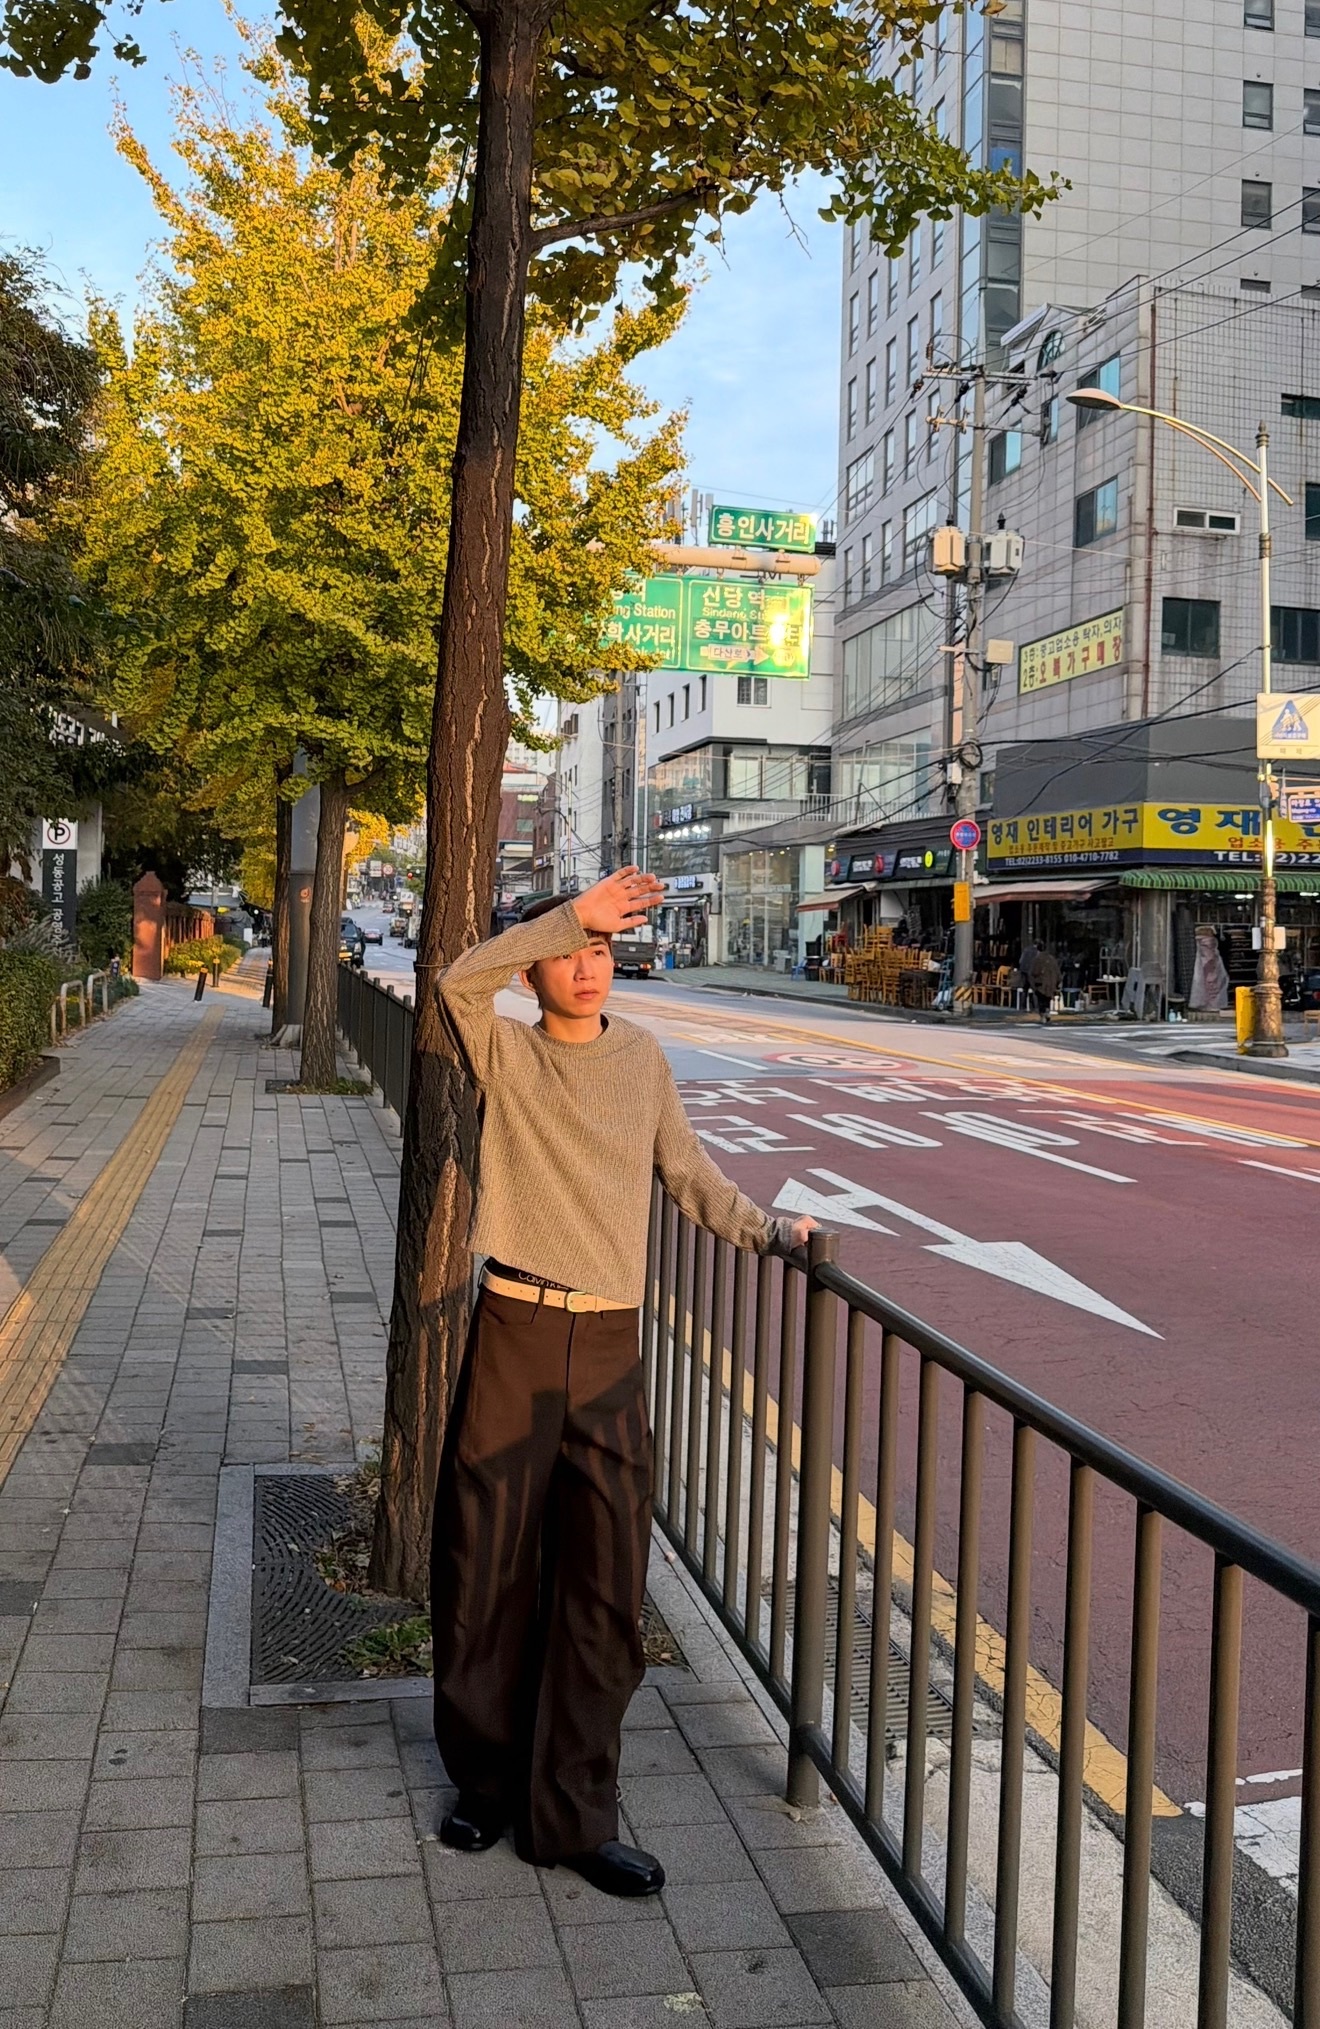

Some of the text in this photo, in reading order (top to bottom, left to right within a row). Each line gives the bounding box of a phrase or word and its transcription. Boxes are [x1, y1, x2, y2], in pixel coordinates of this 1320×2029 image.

[717, 513, 808, 544] 흥인사거리
[634, 603, 676, 619] Station
[991, 808, 1139, 845] 영재 인테리어 가구
[1297, 838, 1320, 850] 주
[1214, 851, 1320, 864] TEL:2)22
